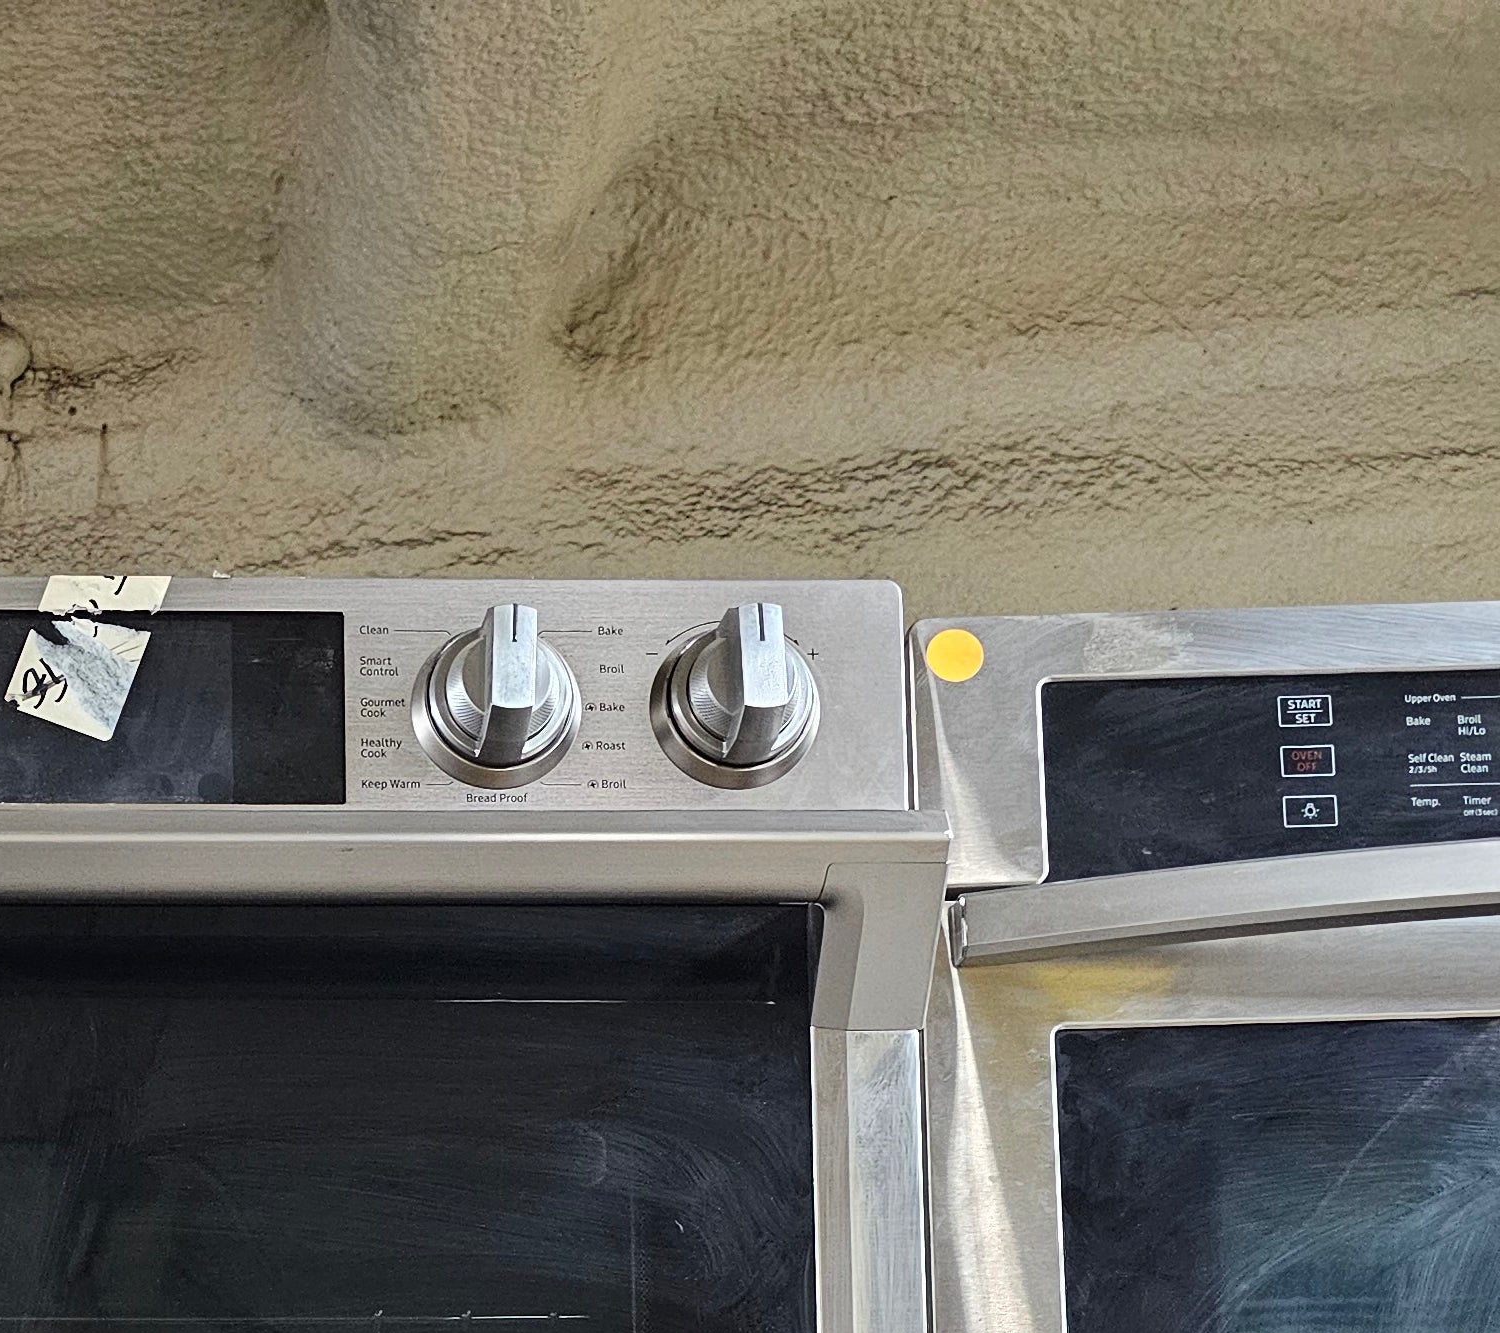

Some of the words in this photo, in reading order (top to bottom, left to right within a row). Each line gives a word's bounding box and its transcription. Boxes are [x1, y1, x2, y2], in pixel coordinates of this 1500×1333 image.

[359, 624, 389, 635] Clean
[597, 625, 624, 636] Bake
[360, 655, 391, 666] Smart
[360, 665, 398, 676] Control
[599, 664, 625, 674] Broil
[360, 697, 406, 708] Gourmet
[1286, 698, 1322, 711] START
[1404, 694, 1432, 705] Upper
[1432, 693, 1457, 703] Oven
[360, 707, 386, 718] Cook
[599, 702, 626, 712] Bake
[1294, 713, 1317, 724] SET
[1405, 716, 1431, 727] Bake
[1457, 714, 1482, 725] Broil
[1457, 725, 1487, 736] Hi/Lo
[360, 738, 403, 751] Healthy
[595, 740, 626, 751] Roast
[360, 748, 387, 759] Cook
[1291, 750, 1323, 761] OVEN
[1407, 753, 1427, 763] Self
[1427, 752, 1455, 763] Clean
[1459, 751, 1492, 763] Steam
[1296, 761, 1317, 772] OFF
[1460, 763, 1489, 774] Clean
[361, 779, 388, 791] Keep
[389, 779, 421, 789] Warm
[601, 779, 627, 789] Broil
[466, 793, 497, 803] Bread
[499, 792, 529, 803] Proof
[1410, 796, 1441, 808] Temp.
[1462, 795, 1492, 806] Timer
